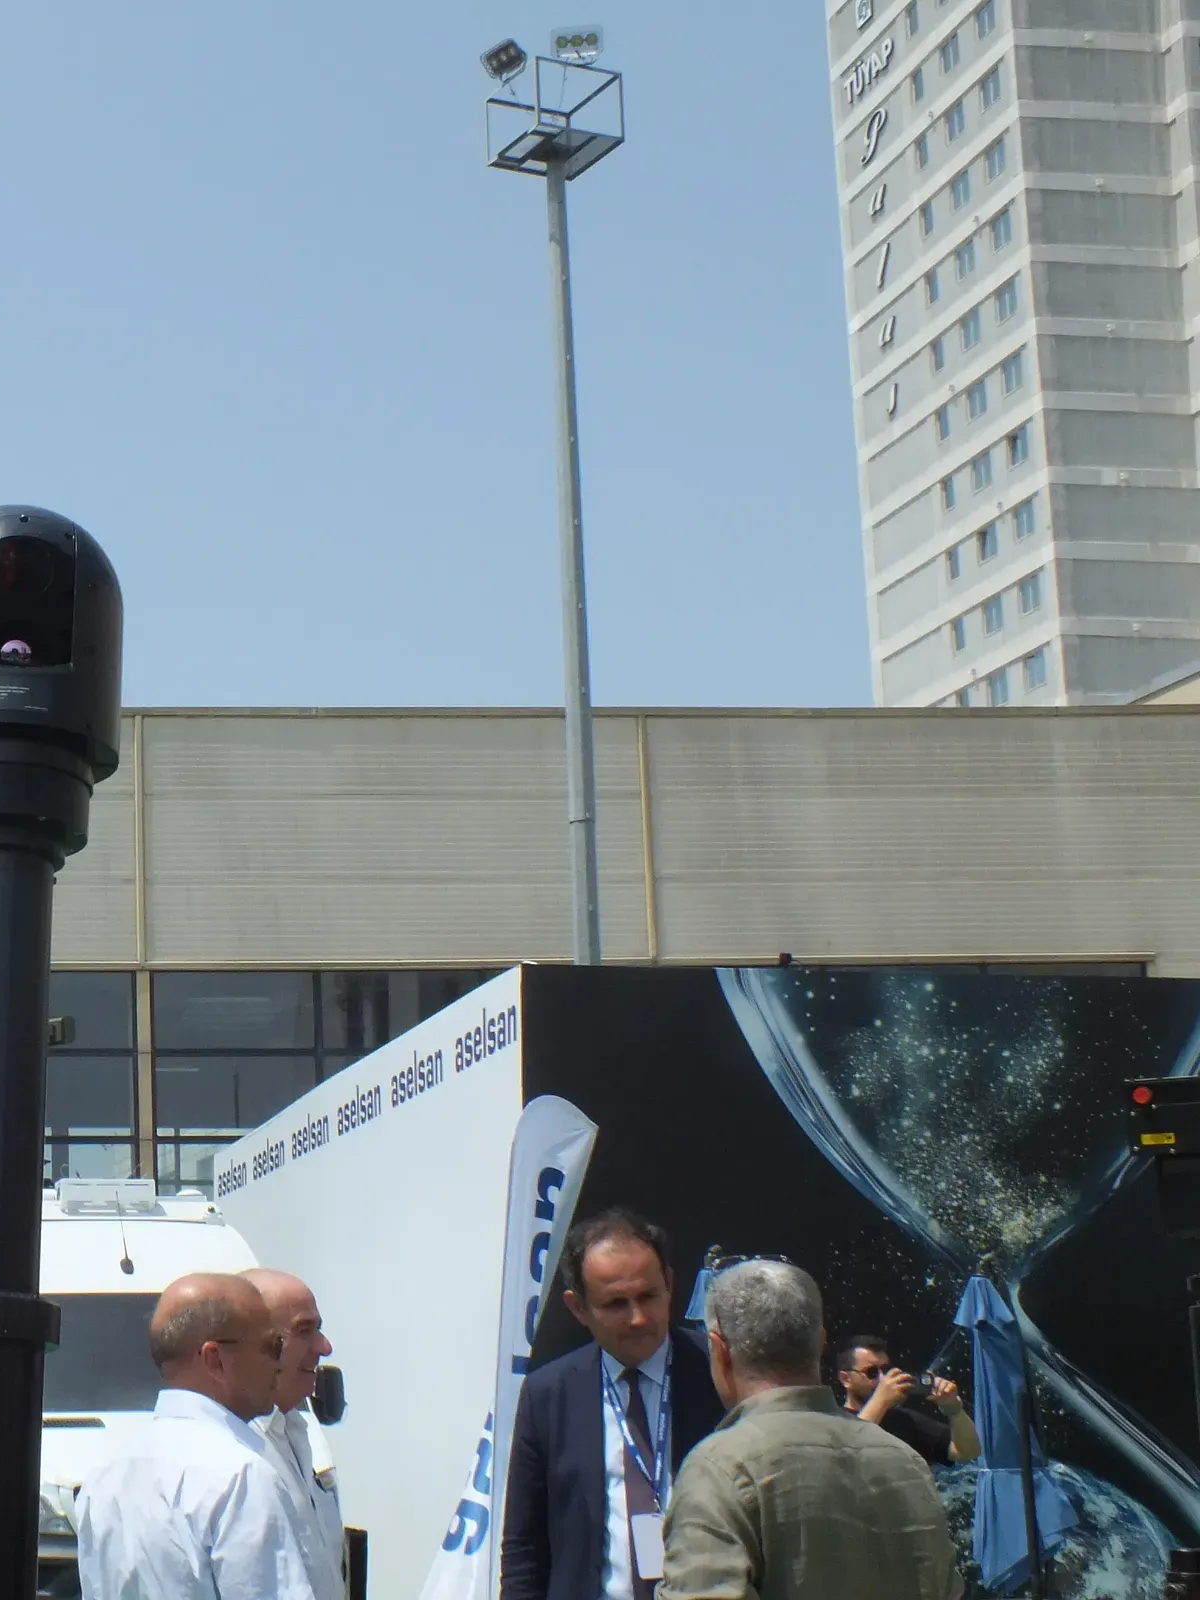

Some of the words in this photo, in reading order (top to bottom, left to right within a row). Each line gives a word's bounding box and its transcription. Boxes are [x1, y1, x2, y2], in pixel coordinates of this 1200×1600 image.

[844, 38, 893, 104] TÜYAP
[217, 1158, 248, 1198] aselsan
[252, 1138, 285, 1181] aselsan
[291, 1113, 330, 1160] aselsan
[337, 1085, 381, 1136] aselsan
[391, 1050, 443, 1108] aselsan
[455, 1005, 517, 1073] aselsan
